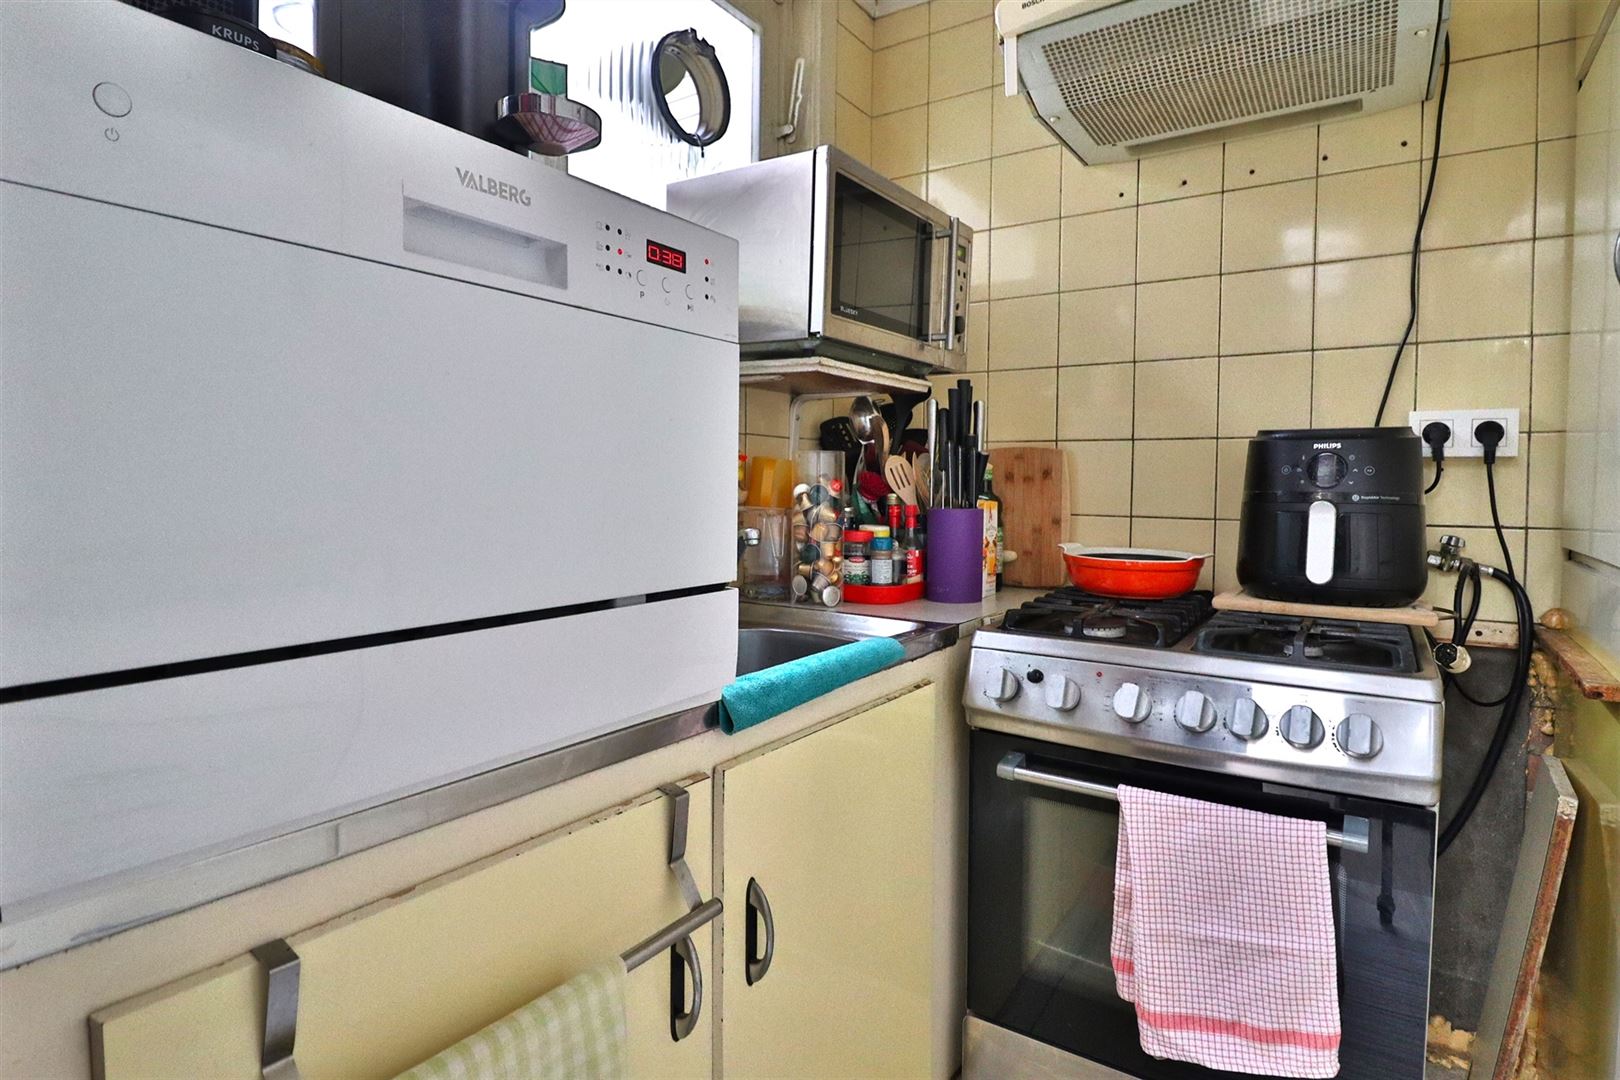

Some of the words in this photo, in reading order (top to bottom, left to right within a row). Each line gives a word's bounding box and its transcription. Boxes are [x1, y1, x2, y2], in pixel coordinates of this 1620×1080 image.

[1021, 0, 1045, 9] BOSC
[211, 24, 260, 51] KRUPS
[455, 166, 532, 207] VALBERG
[1313, 442, 1341, 450] PHILIPS
